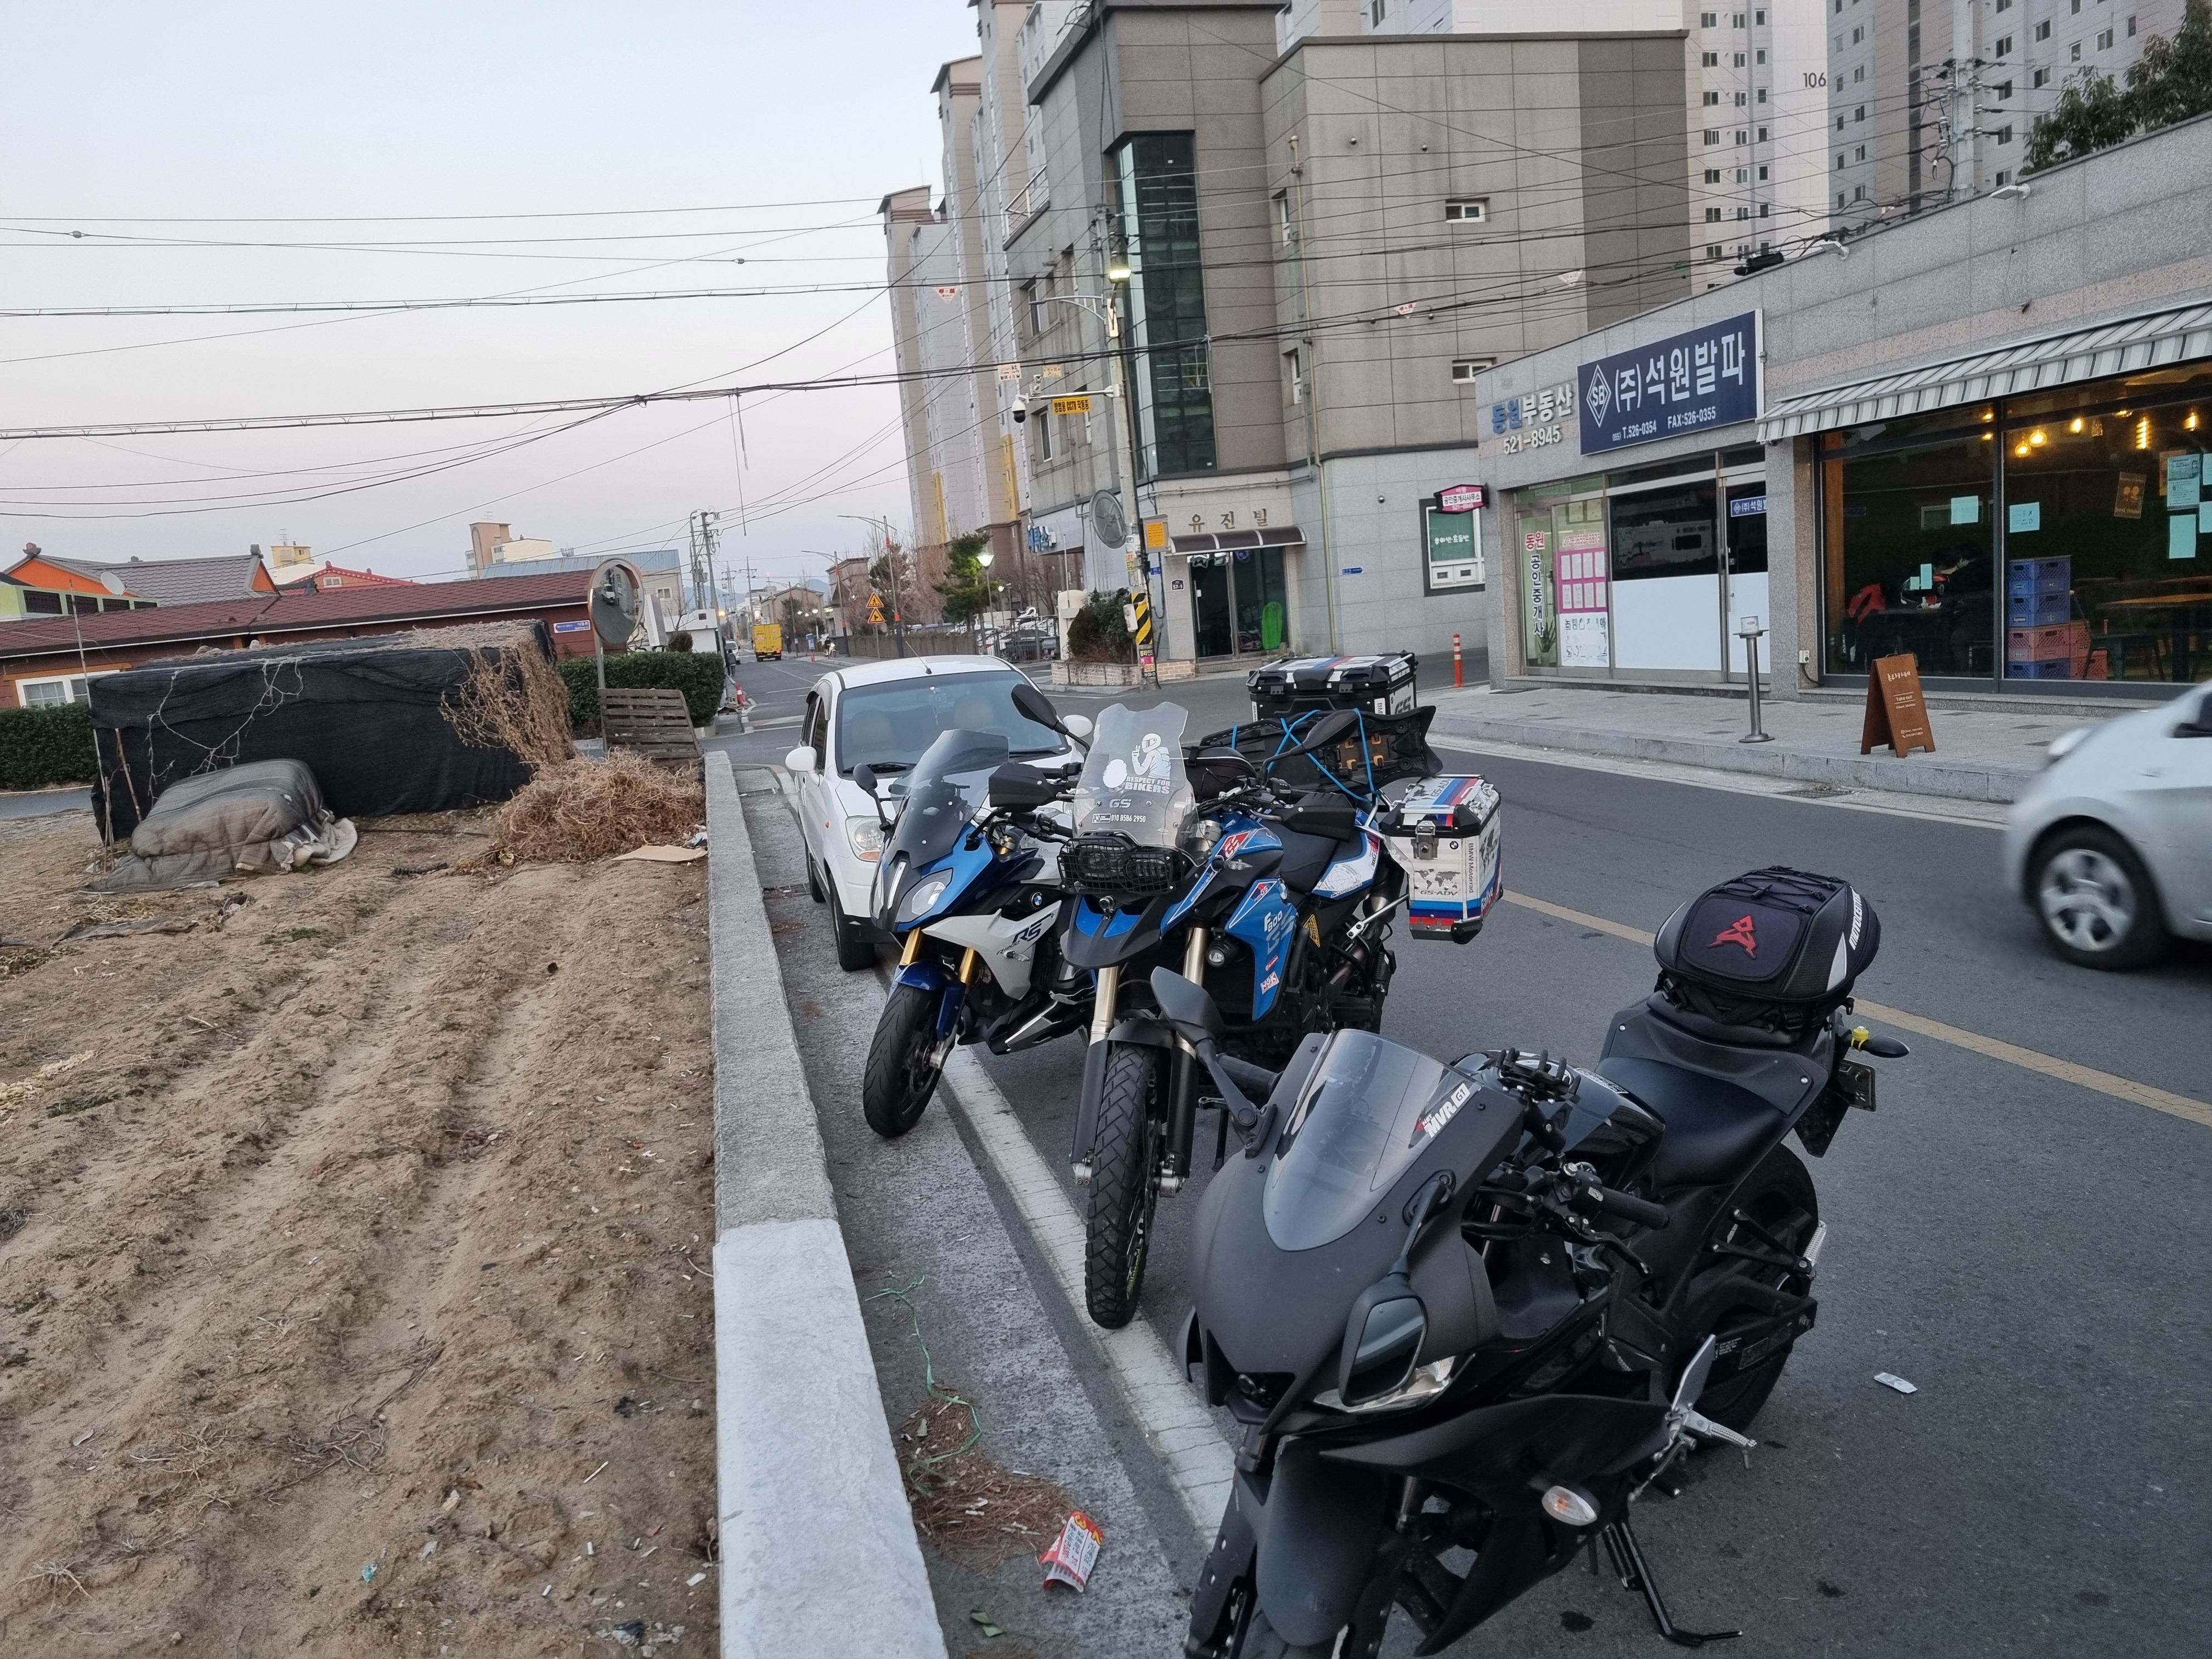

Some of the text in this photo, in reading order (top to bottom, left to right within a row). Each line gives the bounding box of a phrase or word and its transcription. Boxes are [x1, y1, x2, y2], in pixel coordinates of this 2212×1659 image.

[1803, 72, 1826, 88] 106
[1615, 331, 1745, 413] (주)석원발파
[1592, 385, 1606, 407] SB
[1066, 400, 1076, 411] CCTV
[1492, 384, 1573, 434] 동원부동산
[1668, 407, 1716, 429] FAX:526-0355
[1504, 424, 1561, 454] 521-8945
[1444, 493, 1480, 505] 공인중개사사무소
[1526, 531, 1544, 550] 동원
[1531, 554, 1543, 637] 공인중개사
[1125, 782, 1170, 794] BIKERS
[1126, 776, 1156, 785] RESPECT
[1109, 799, 1132, 808] GS
[1261, 973, 1277, 992] NGK
[1074, 1515, 1087, 1530] 3
[1091, 1531, 1102, 1545] 2
